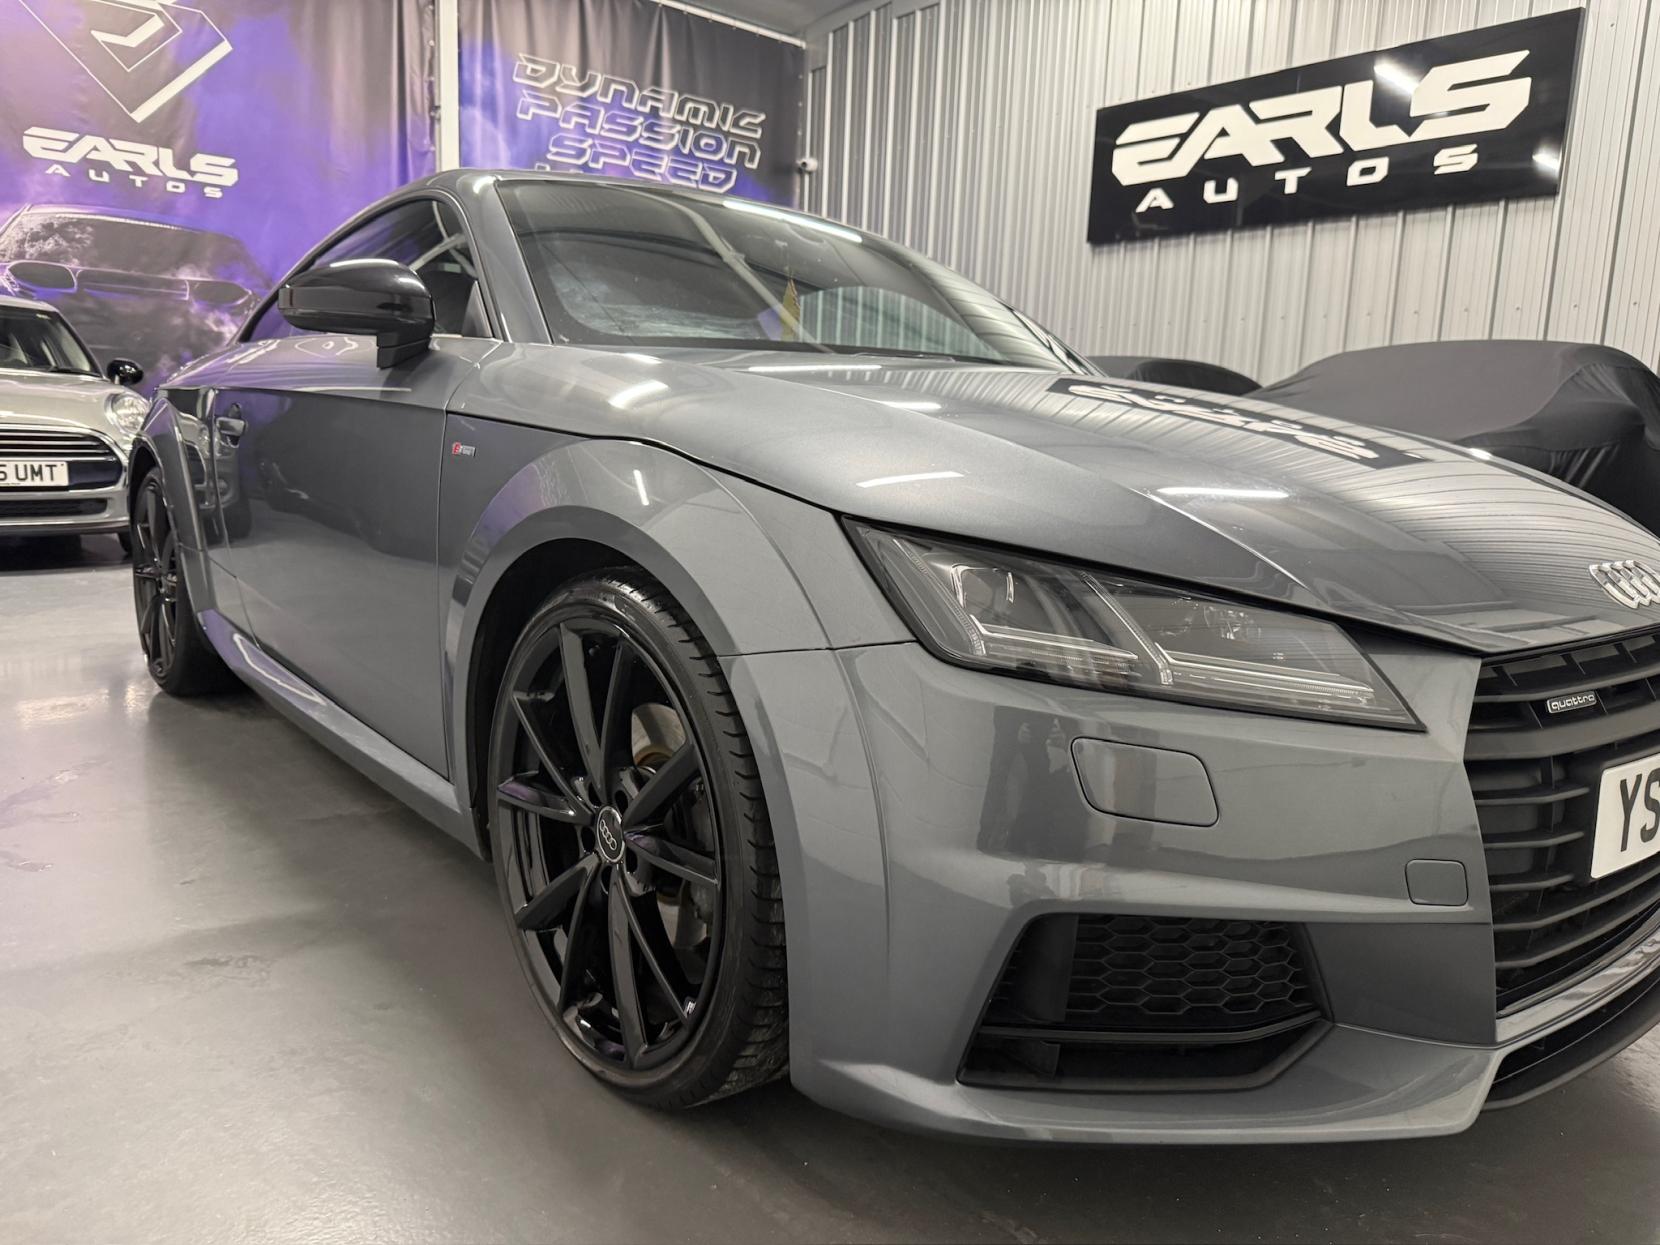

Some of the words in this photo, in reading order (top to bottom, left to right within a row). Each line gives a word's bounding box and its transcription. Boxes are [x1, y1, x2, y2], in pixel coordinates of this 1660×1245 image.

[512, 53, 766, 138] DYNAMIC
[1111, 49, 1532, 187] EARLS
[22, 126, 239, 187] EARLS
[516, 90, 761, 169] PASSION
[45, 164, 223, 199] AUTOS
[547, 132, 737, 194] SPEED
[1135, 144, 1478, 213] AUTOS
[14, 463, 57, 482] UMT
[1551, 694, 1595, 711] quattro
